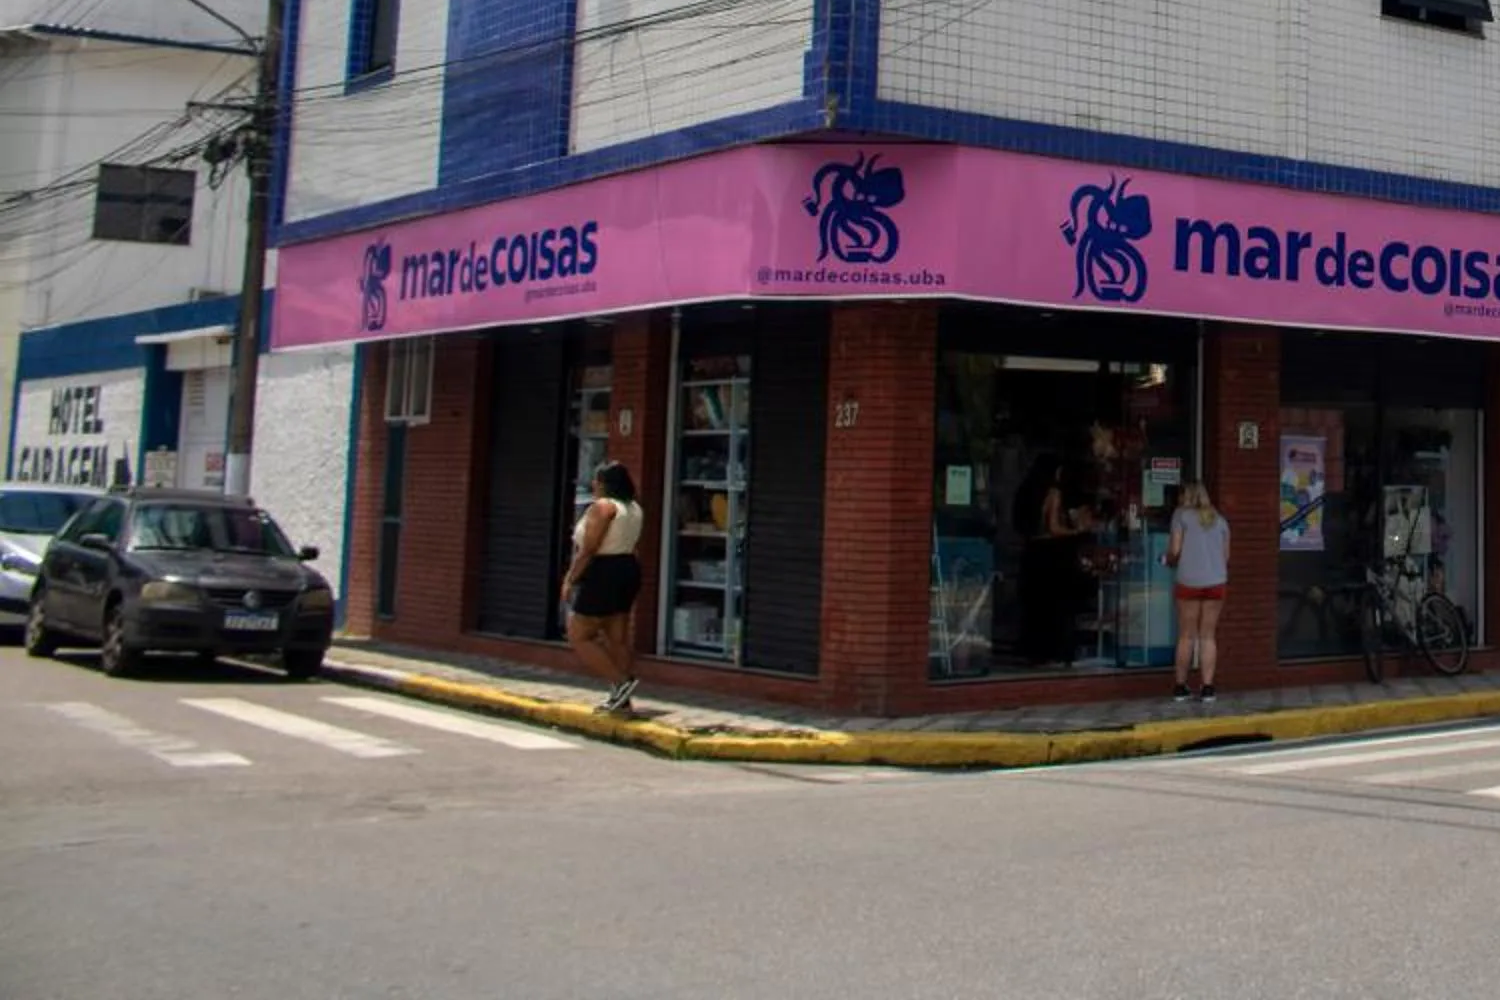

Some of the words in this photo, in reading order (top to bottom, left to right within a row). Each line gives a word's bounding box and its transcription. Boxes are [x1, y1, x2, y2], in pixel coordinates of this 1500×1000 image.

[757, 265, 946, 286] @mardecoisas.uba
[49, 385, 103, 435] HOTEL
[835, 401, 859, 428] 237
